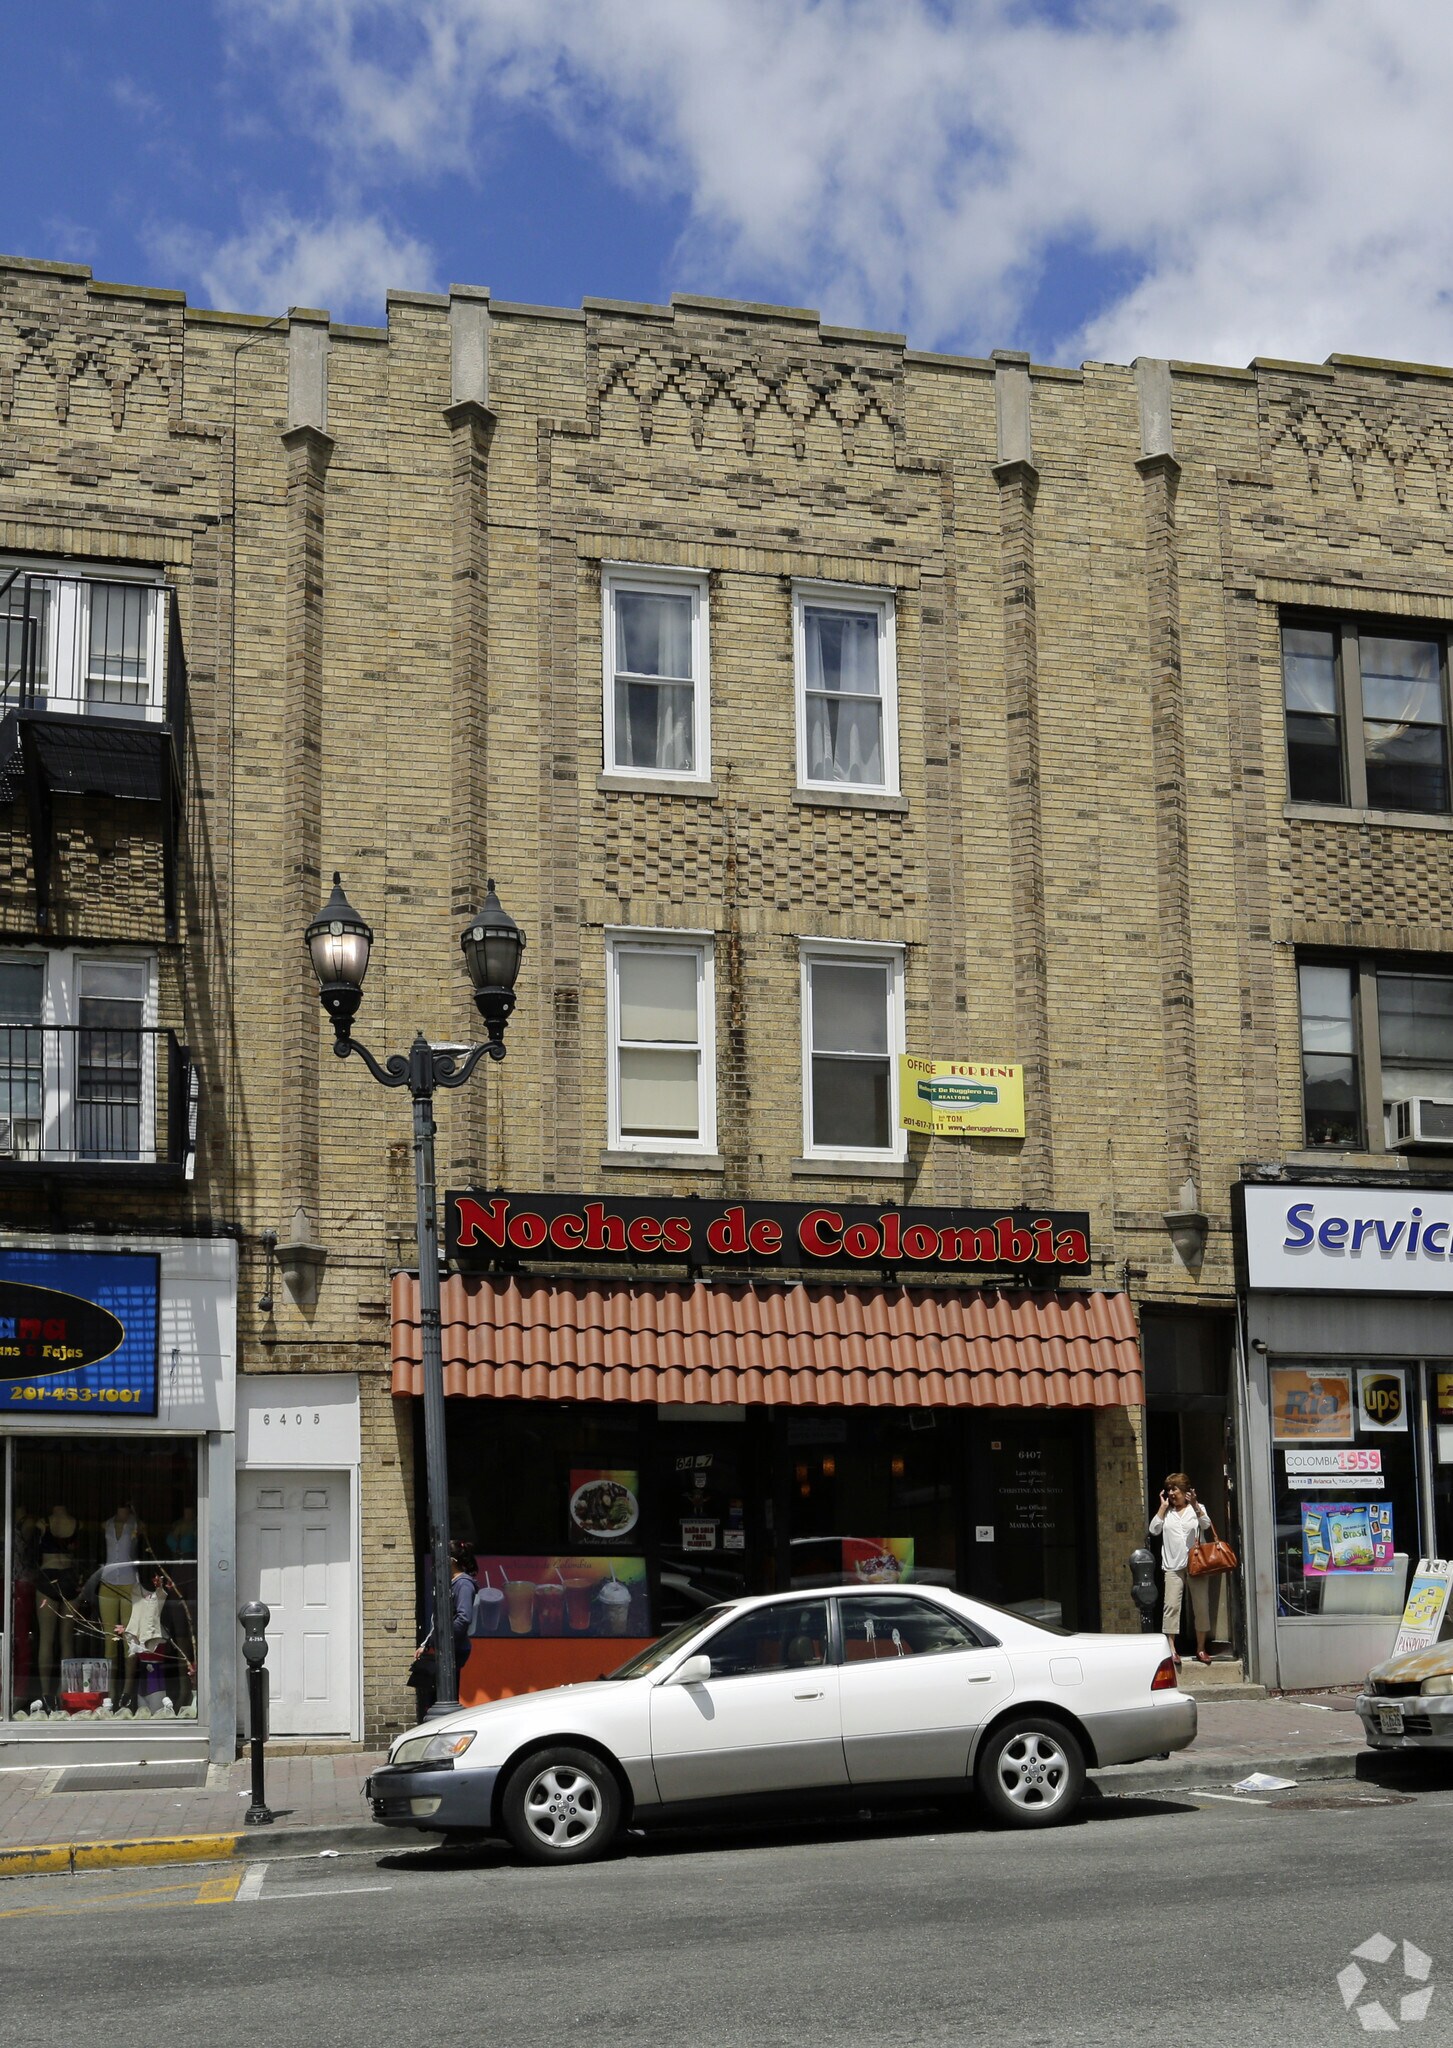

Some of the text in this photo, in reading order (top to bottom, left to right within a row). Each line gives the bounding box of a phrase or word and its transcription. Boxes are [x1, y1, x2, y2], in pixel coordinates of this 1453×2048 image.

[907, 1058, 1015, 1078] OFFICE FOR RENT
[949, 1087, 982, 1095] Ruggiero
[454, 1197, 1089, 1264] Noches de Colombia
[1283, 1203, 1453, 1256] Servic
[42, 1345, 84, 1361] Fajas
[10, 1386, 142, 1403] 201-453-1001
[1285, 1382, 1339, 1415] Ria
[1366, 1389, 1400, 1418] ups
[263, 1413, 320, 1425] 6405
[1018, 1451, 1042, 1459] 6407
[1286, 1451, 1380, 1470] COLOMBIA 1959
[1343, 1528, 1368, 1540] Brasil
[1397, 1635, 1430, 1653] PASSPORT
